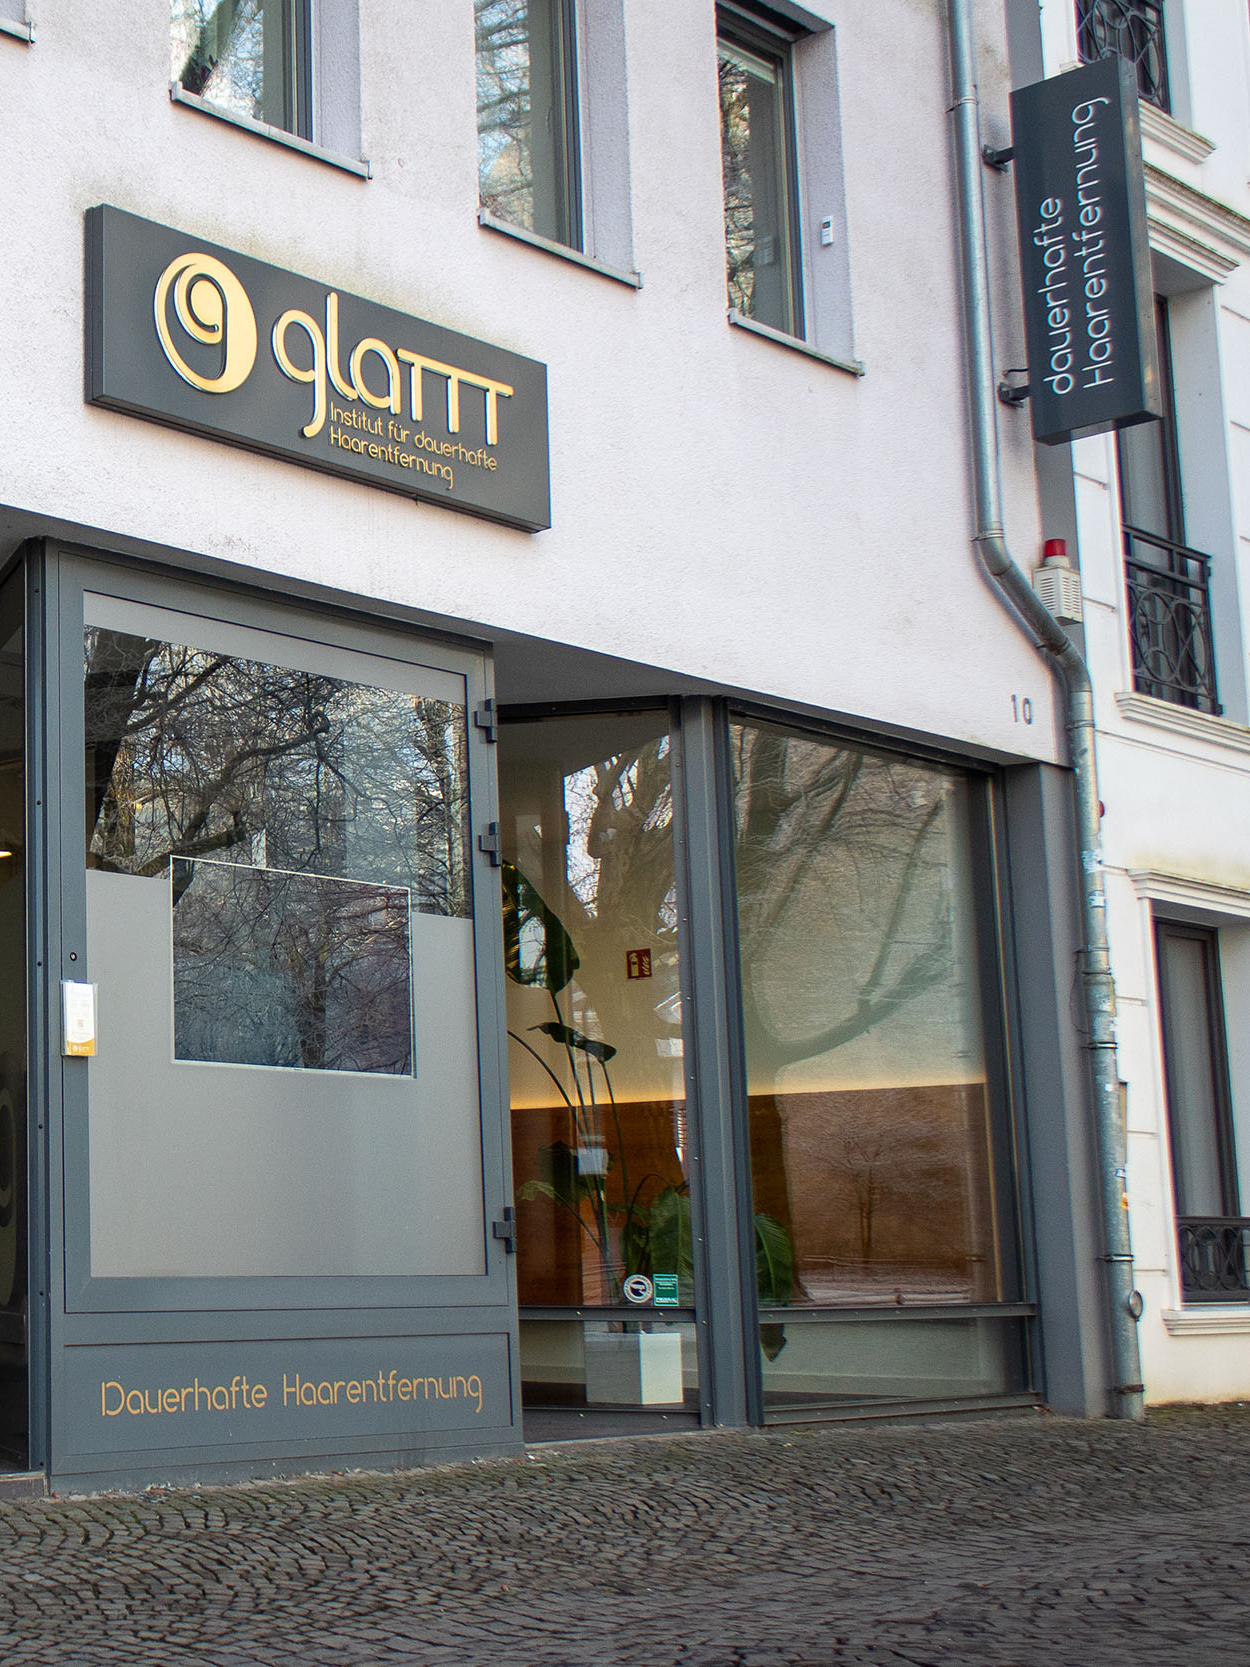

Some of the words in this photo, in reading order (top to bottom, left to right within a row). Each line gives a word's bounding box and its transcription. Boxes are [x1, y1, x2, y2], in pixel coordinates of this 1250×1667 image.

[1071, 96, 1114, 390] Haarentfernung
[1033, 196, 1075, 395] dauerhafte
[330, 401, 383, 436] Institut
[388, 420, 410, 443] für
[414, 430, 498, 471] dauerhafte
[330, 425, 454, 489] Haarentfernung
[1010, 694, 1033, 725] 10
[101, 1375, 268, 1416] Dauerhafte
[283, 1370, 482, 1413] Haarentfernung
